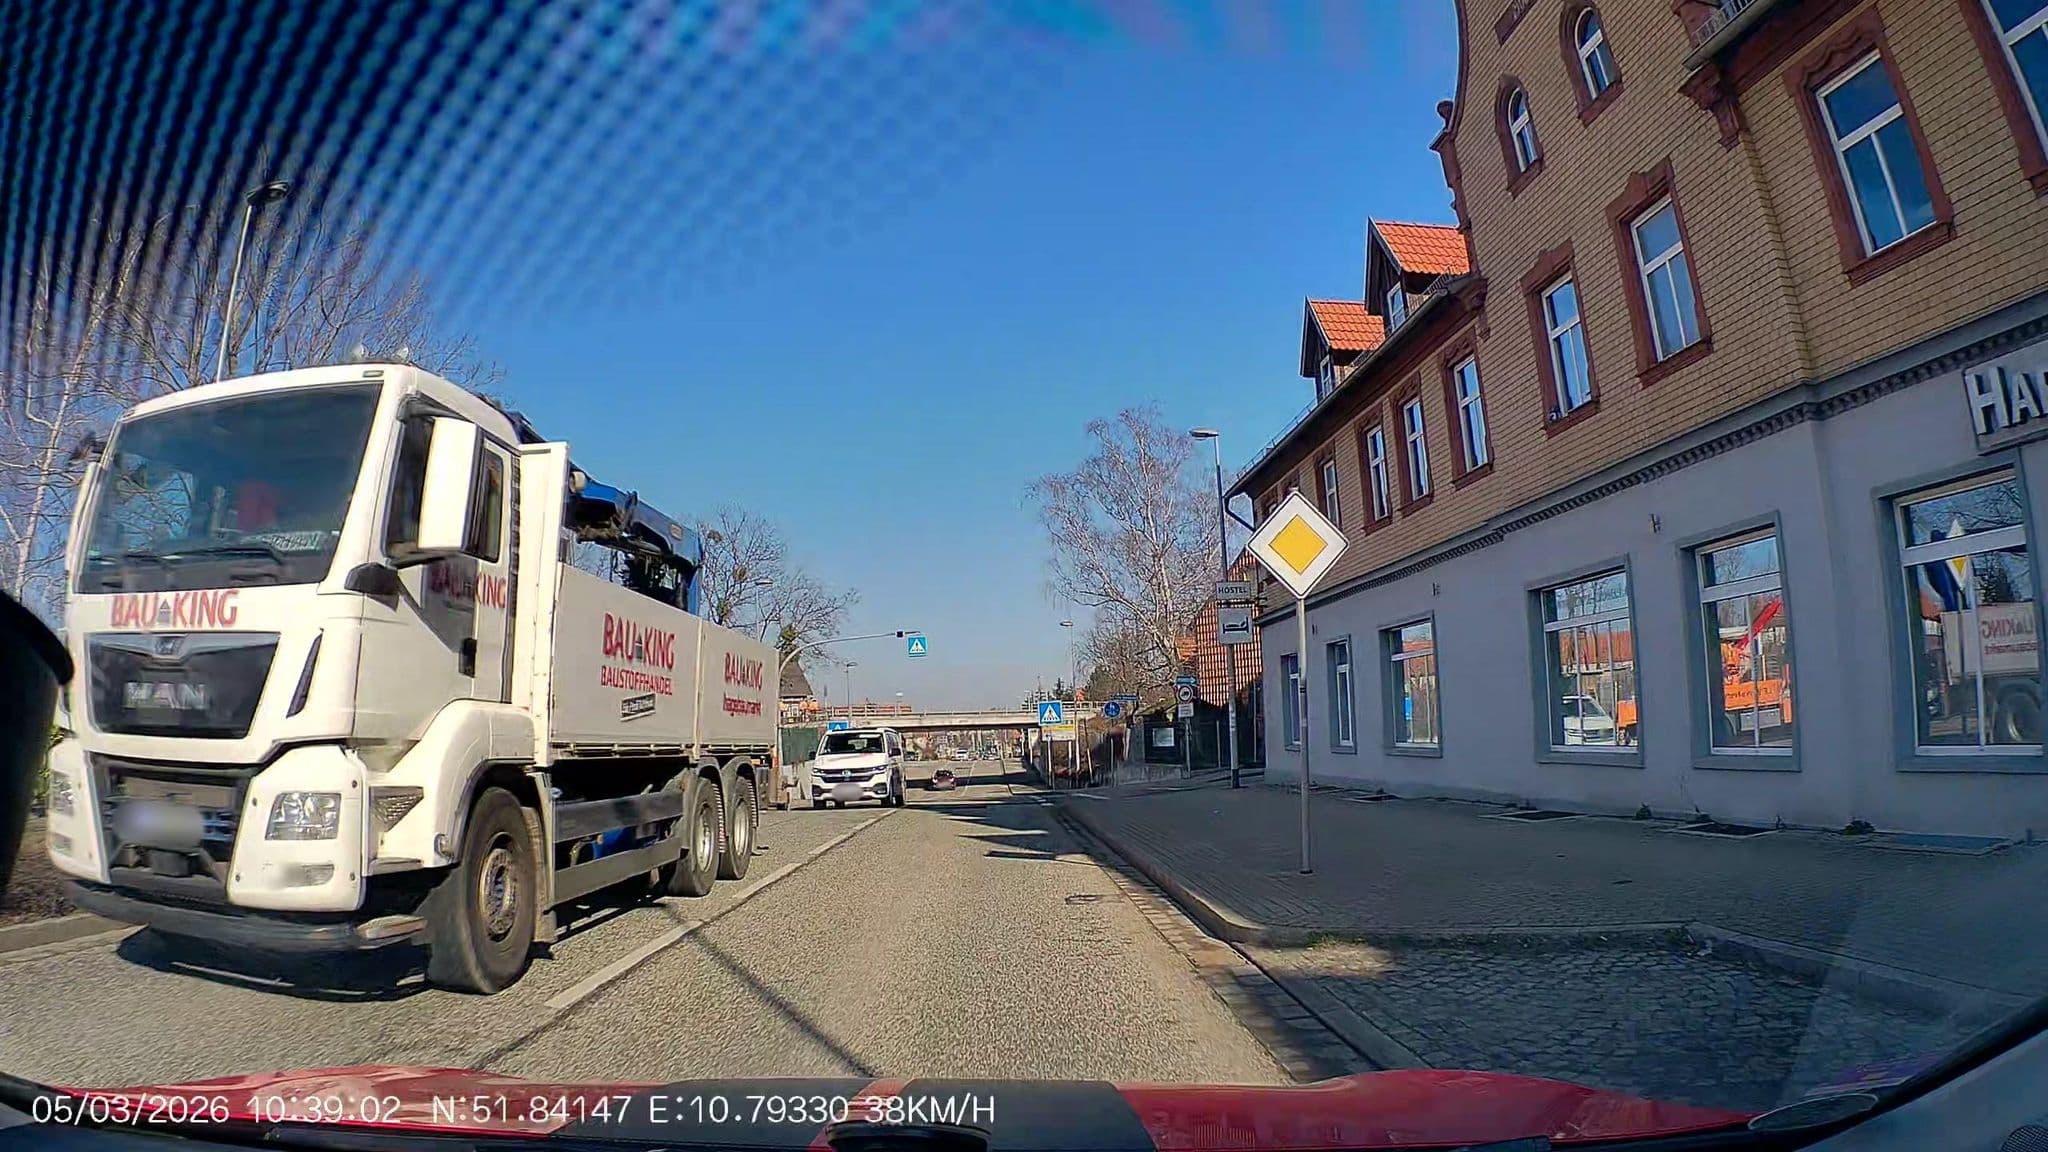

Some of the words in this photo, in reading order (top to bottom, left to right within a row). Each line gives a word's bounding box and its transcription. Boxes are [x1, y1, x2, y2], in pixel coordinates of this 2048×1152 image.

[1965, 366, 2048, 435] HA
[1217, 586, 1248, 594] HOSTEL
[601, 665, 673, 696] BAUSTOFFHANDEL
